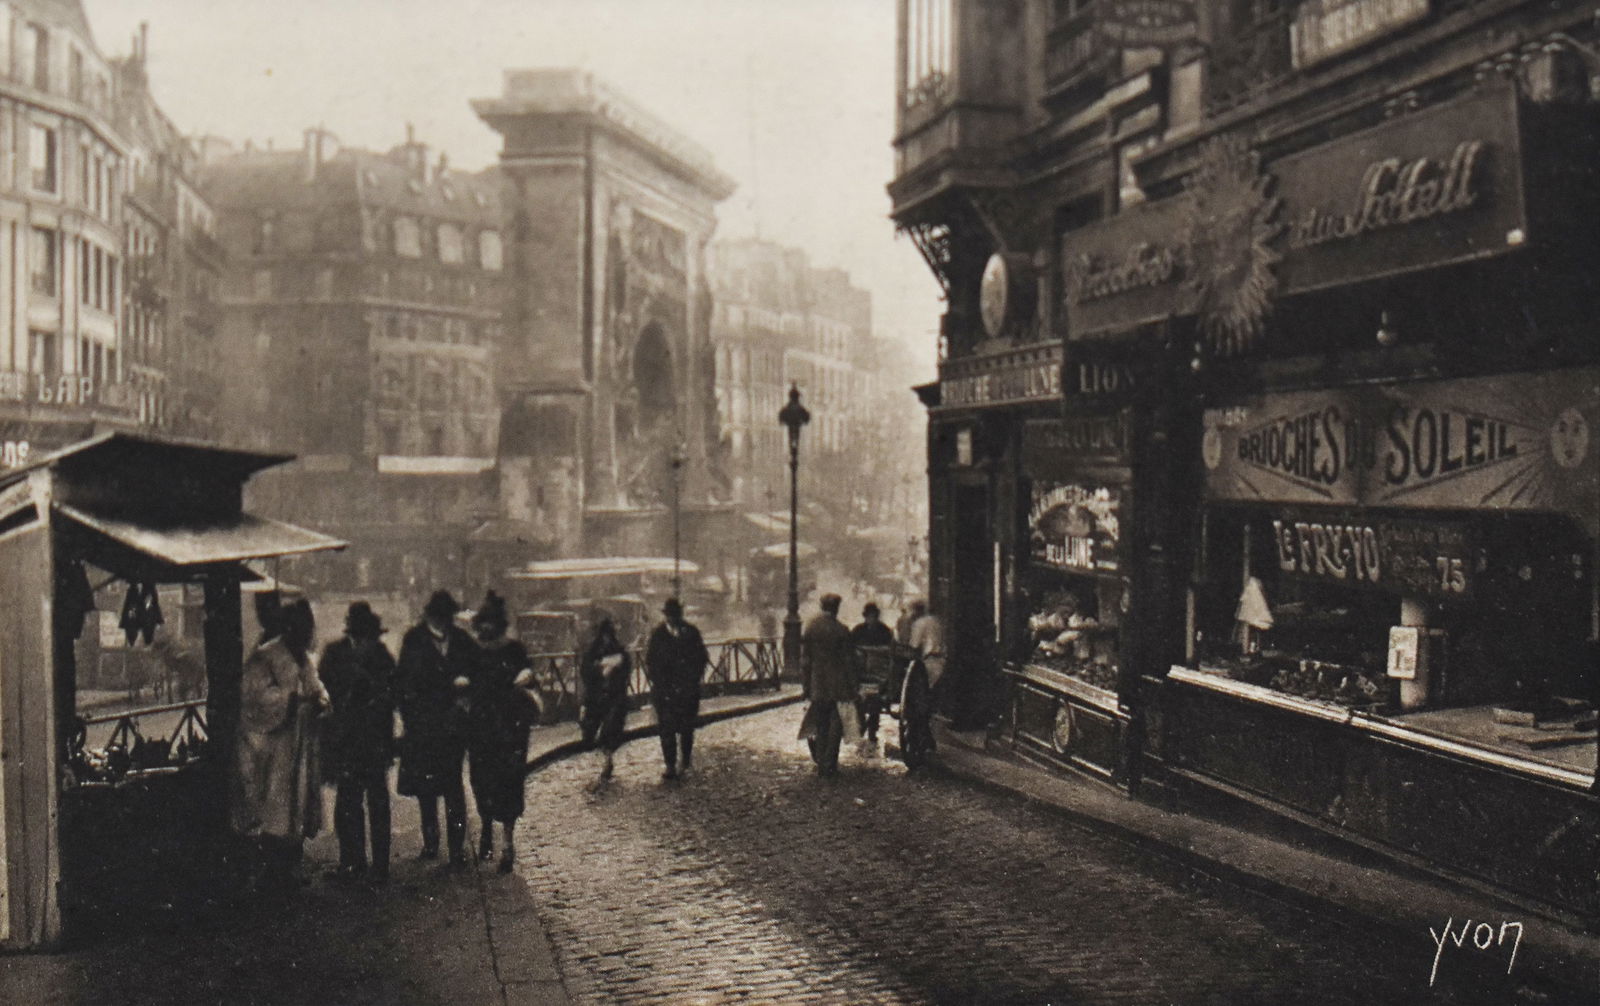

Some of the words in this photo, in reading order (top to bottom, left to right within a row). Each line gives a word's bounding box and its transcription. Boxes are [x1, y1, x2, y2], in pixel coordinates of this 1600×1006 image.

[1239, 405, 1341, 485] BRIOCHES
[1386, 400, 1518, 485] SOLEIL
[1065, 535, 1094, 569] LUNE
[1436, 556, 1466, 592] 75
